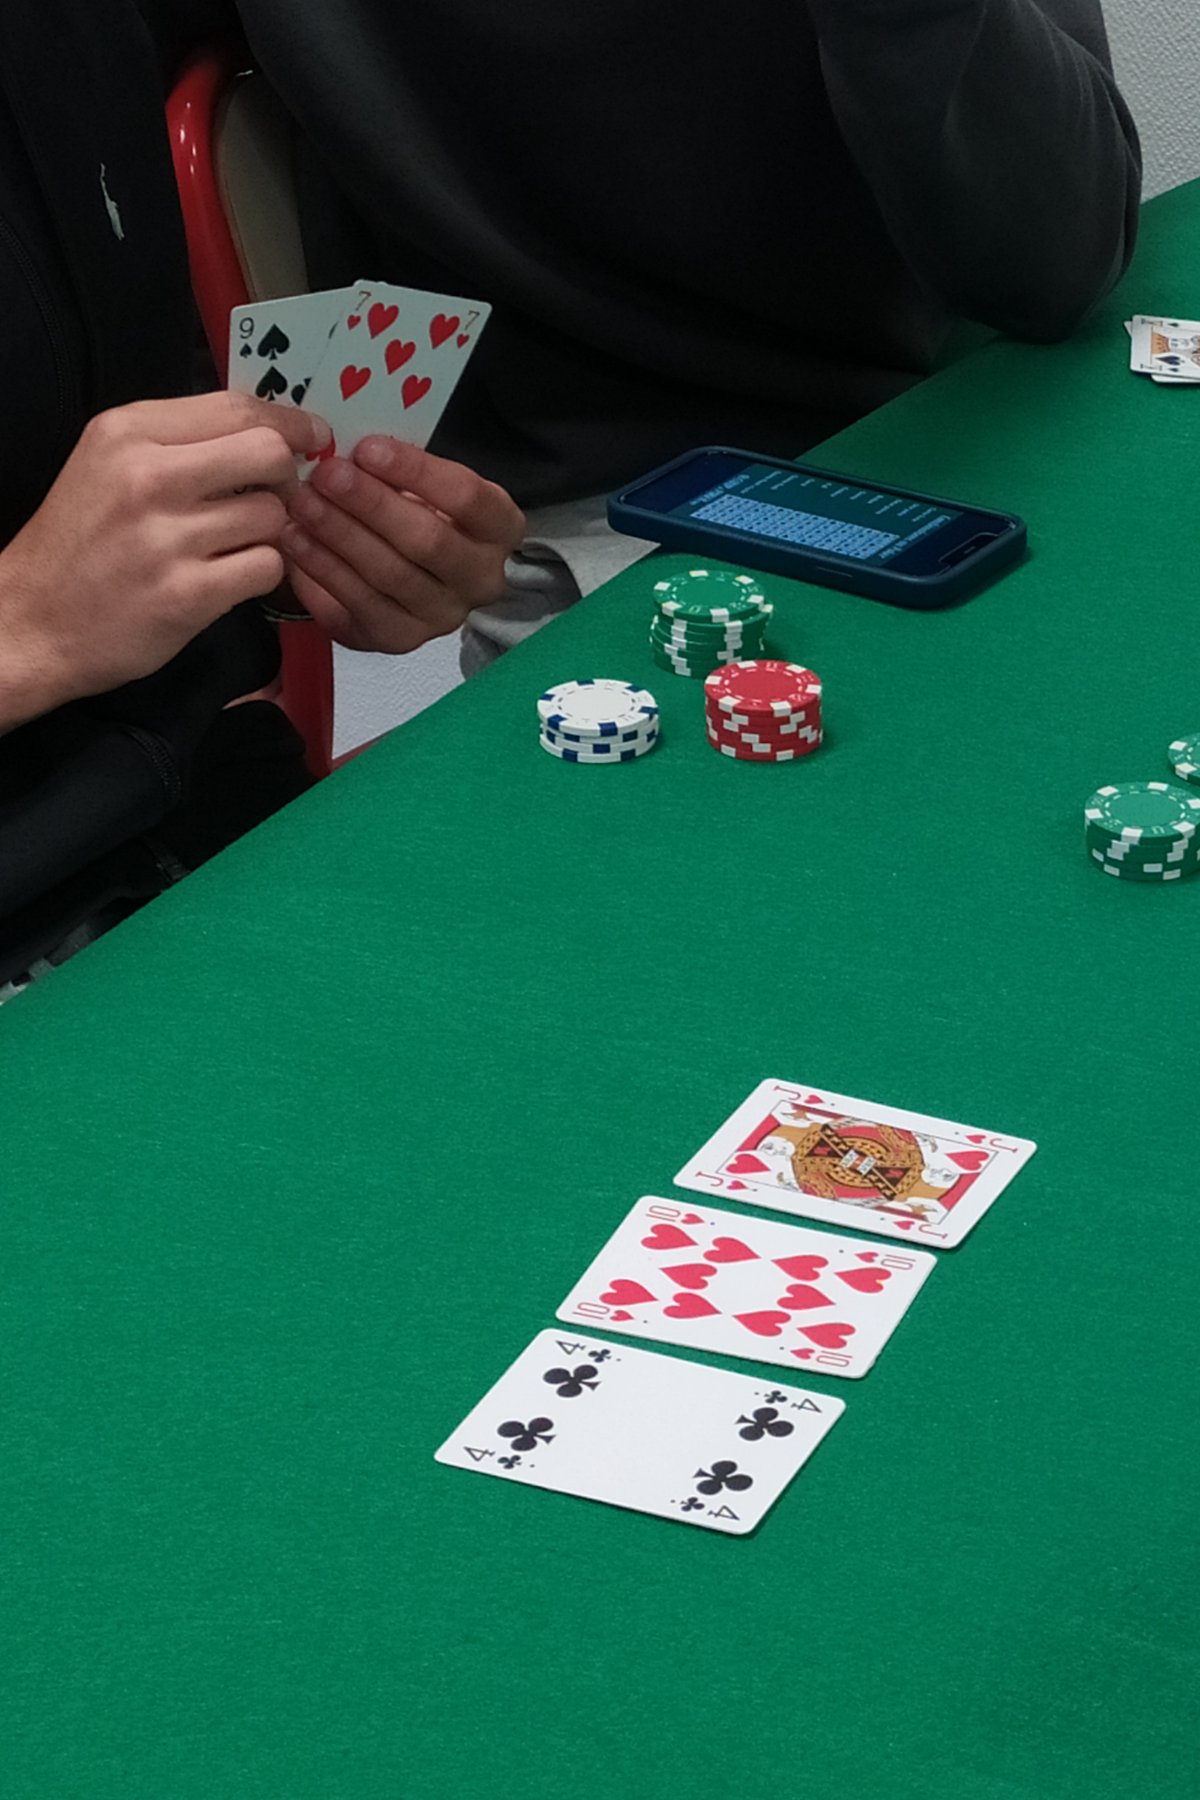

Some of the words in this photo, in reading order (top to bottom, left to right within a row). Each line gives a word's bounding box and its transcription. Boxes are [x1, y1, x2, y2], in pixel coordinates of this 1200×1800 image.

[355, 290, 372, 311] 7
[239, 317, 254, 339] 9
[464, 310, 480, 331] 7
[774, 1085, 802, 1101] J
[989, 1138, 1018, 1154] J
[696, 1171, 724, 1187] J
[645, 1204, 681, 1222] 10
[919, 1223, 948, 1239] J
[880, 1253, 917, 1271] 10
[572, 1301, 610, 1320] 10
[556, 1340, 587, 1356] 4
[815, 1350, 853, 1368] 10
[791, 1398, 823, 1414] 4
[463, 1446, 496, 1462] 4
[707, 1504, 741, 1521] 4
